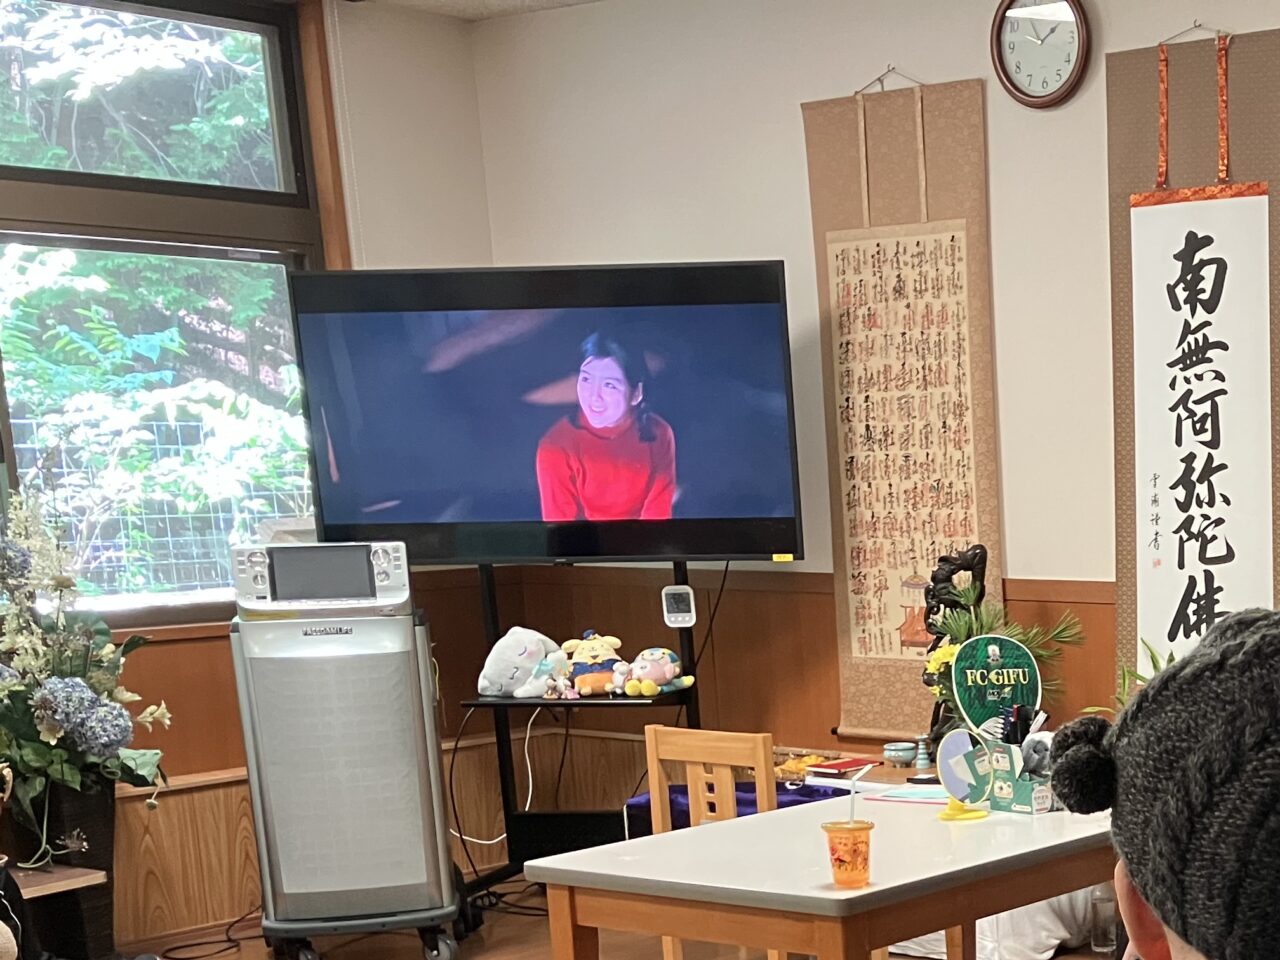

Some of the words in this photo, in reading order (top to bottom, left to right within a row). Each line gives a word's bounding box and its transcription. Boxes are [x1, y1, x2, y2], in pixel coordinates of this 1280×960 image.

[1008, 41, 1015, 54] 9
[1064, 52, 1071, 65] 4
[1014, 61, 1021, 74] 8
[1026, 74, 1033, 87] 7
[1055, 69, 1062, 82] 5
[1041, 77, 1049, 89] 6
[965, 669, 988, 686] FC
[988, 668, 1029, 685] GIFU
